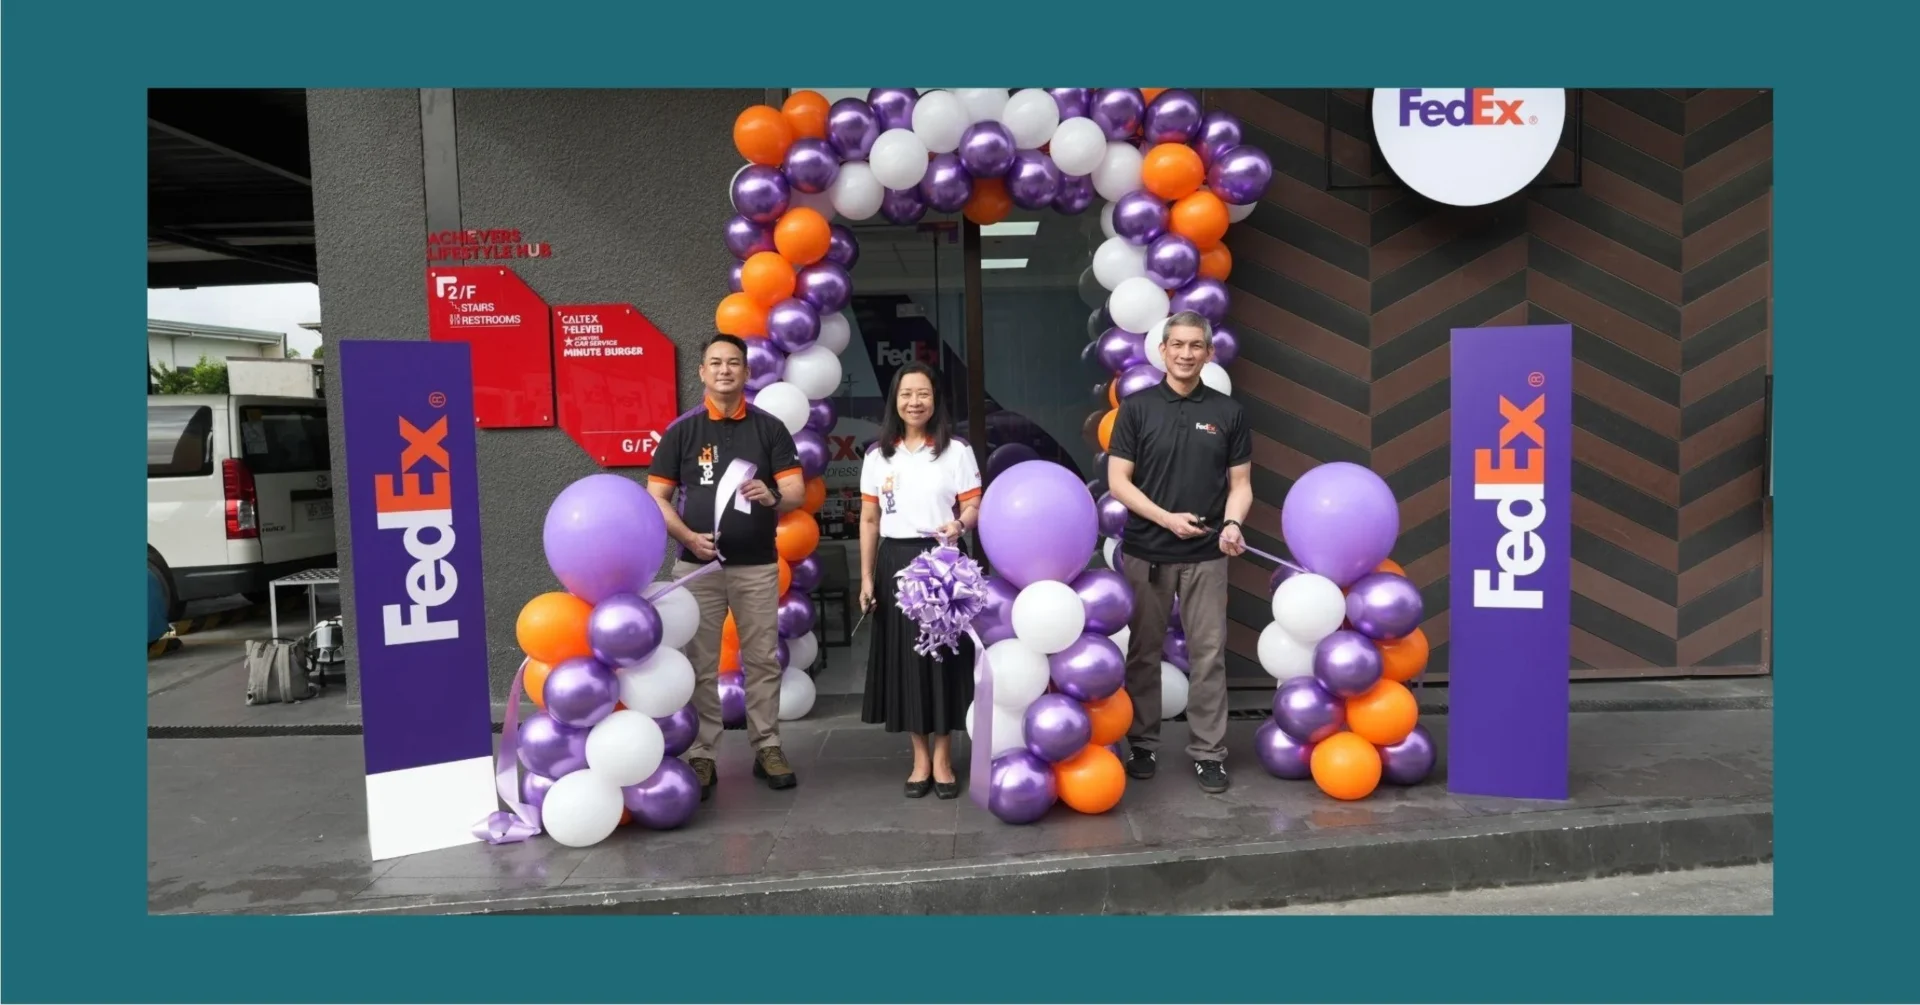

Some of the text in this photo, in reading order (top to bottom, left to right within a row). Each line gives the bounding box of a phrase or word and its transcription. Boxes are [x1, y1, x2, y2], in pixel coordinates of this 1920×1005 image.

[428, 229, 521, 245] ACHIEVERS
[427, 242, 552, 261] LIFESTYLE HUB
[447, 284, 477, 300] 2/F
[461, 302, 495, 312] STAIRS
[461, 314, 521, 324] RESTROOMS
[561, 314, 599, 324] CALTEX
[563, 346, 644, 357] MINUTE BURGER
[622, 438, 652, 453] G/F
[697, 446, 714, 485] FedEx
